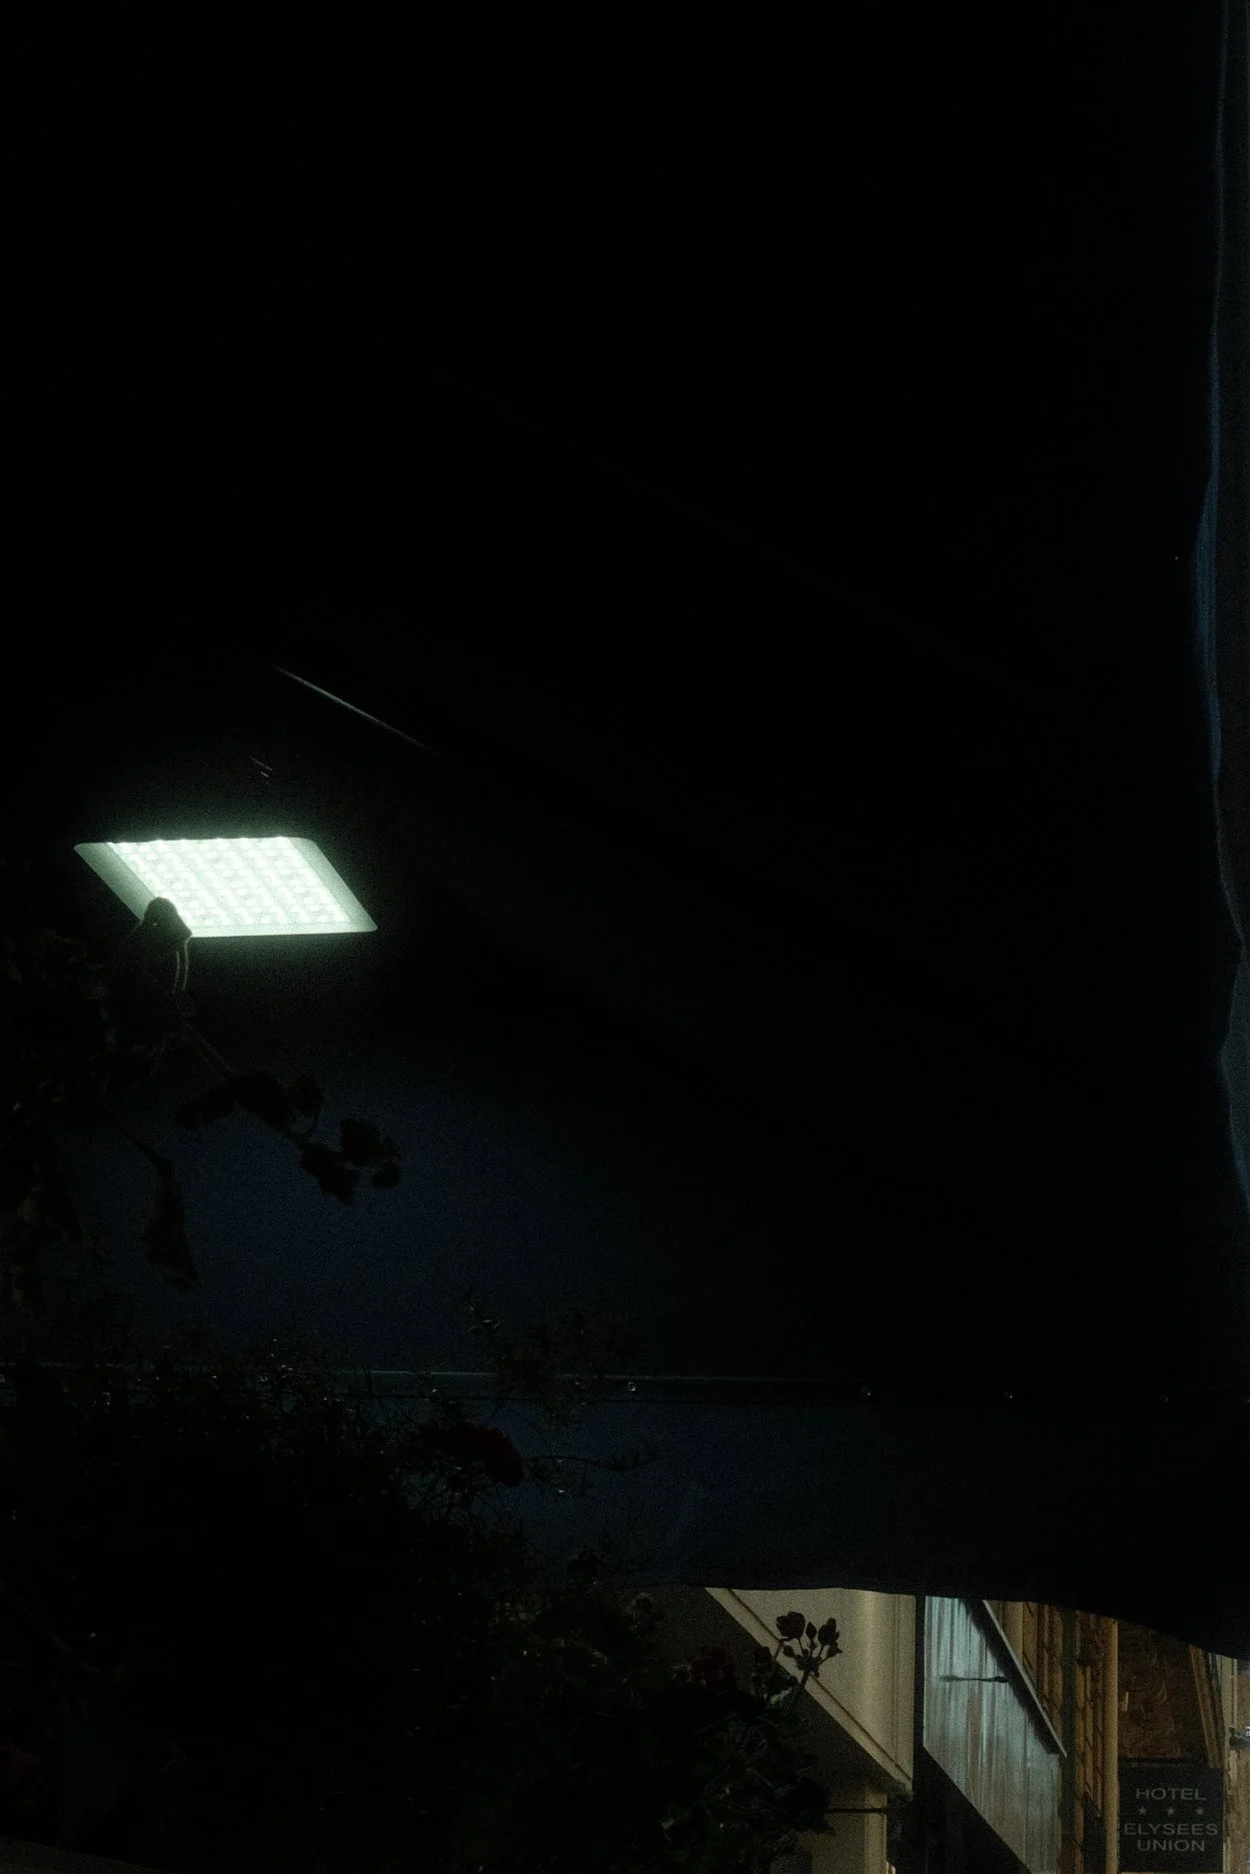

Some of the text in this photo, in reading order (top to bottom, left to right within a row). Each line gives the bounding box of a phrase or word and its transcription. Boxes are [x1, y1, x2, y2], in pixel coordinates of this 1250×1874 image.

[1135, 1787, 1206, 1801] HOTEL
[1124, 1823, 1218, 1836] ELYSEES
[1137, 1839, 1205, 1852] UNION
